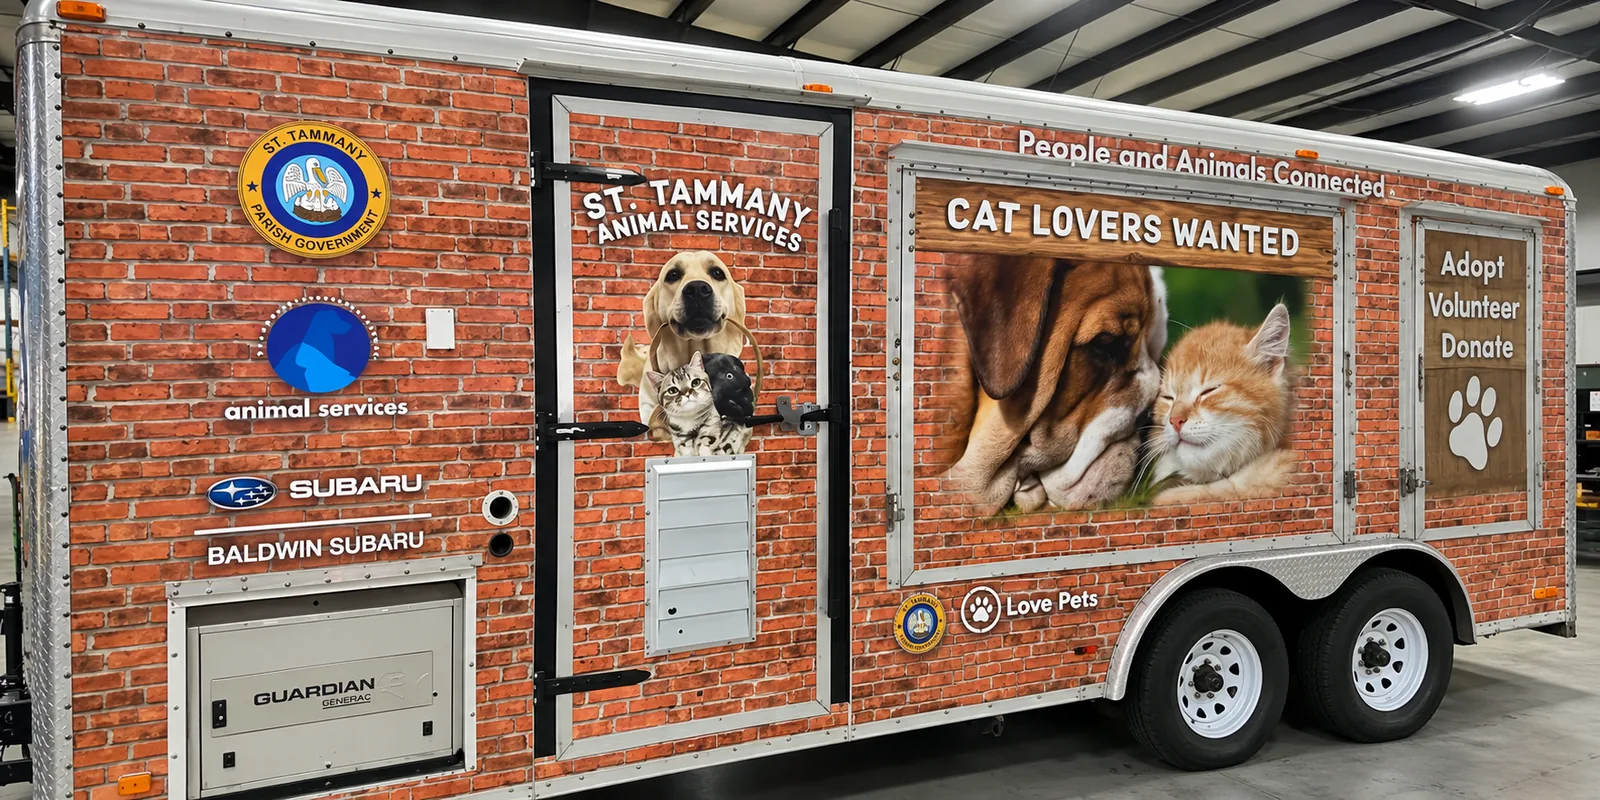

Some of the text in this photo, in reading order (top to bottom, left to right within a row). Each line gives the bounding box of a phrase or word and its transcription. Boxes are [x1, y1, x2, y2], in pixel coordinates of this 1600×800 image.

[262, 129, 367, 161] ST. TAMMANY
[1018, 129, 1385, 198] People and Animals Connected
[583, 178, 812, 229] ST. TAMMANY
[251, 203, 378, 251] PARISH GOVERNMENT
[598, 209, 803, 252] ANIMAL SERVICES
[947, 197, 1299, 257] CAT LOVERS WANTED
[1440, 250, 1505, 286] Adopt
[1428, 291, 1521, 320] Volunteer
[1441, 332, 1514, 359] Donate
[224, 397, 408, 421] animal services
[289, 474, 423, 499] SUBARU
[207, 531, 424, 566] BALDWIN SUBARU
[1006, 590, 1099, 616] Love Pets
[253, 677, 375, 706] GUARDIAN
[322, 693, 371, 707] GENERAC
